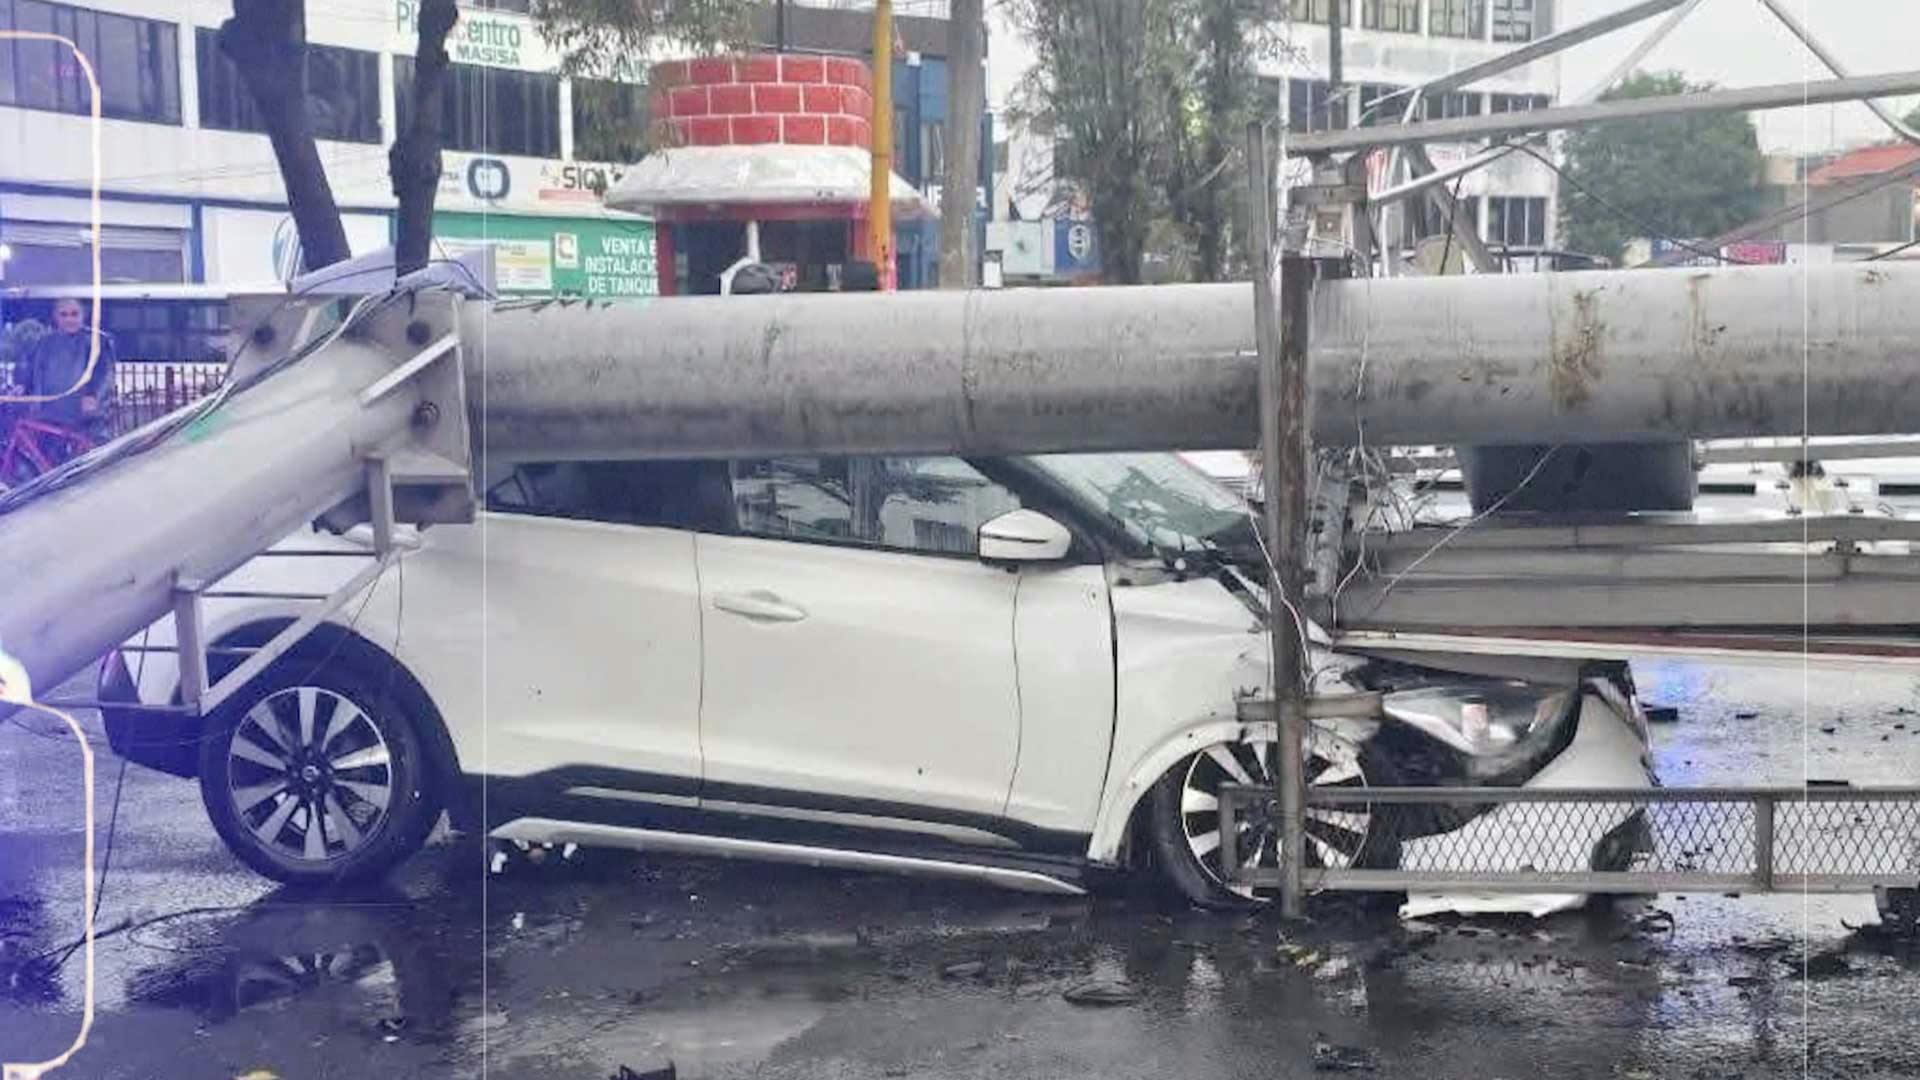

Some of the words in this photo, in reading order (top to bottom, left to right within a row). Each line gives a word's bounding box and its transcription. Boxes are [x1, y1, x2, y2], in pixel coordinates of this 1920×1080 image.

[456, 44, 520, 65] MASISA
[601, 236, 647, 256] VENTA
[588, 275, 607, 295] DE
